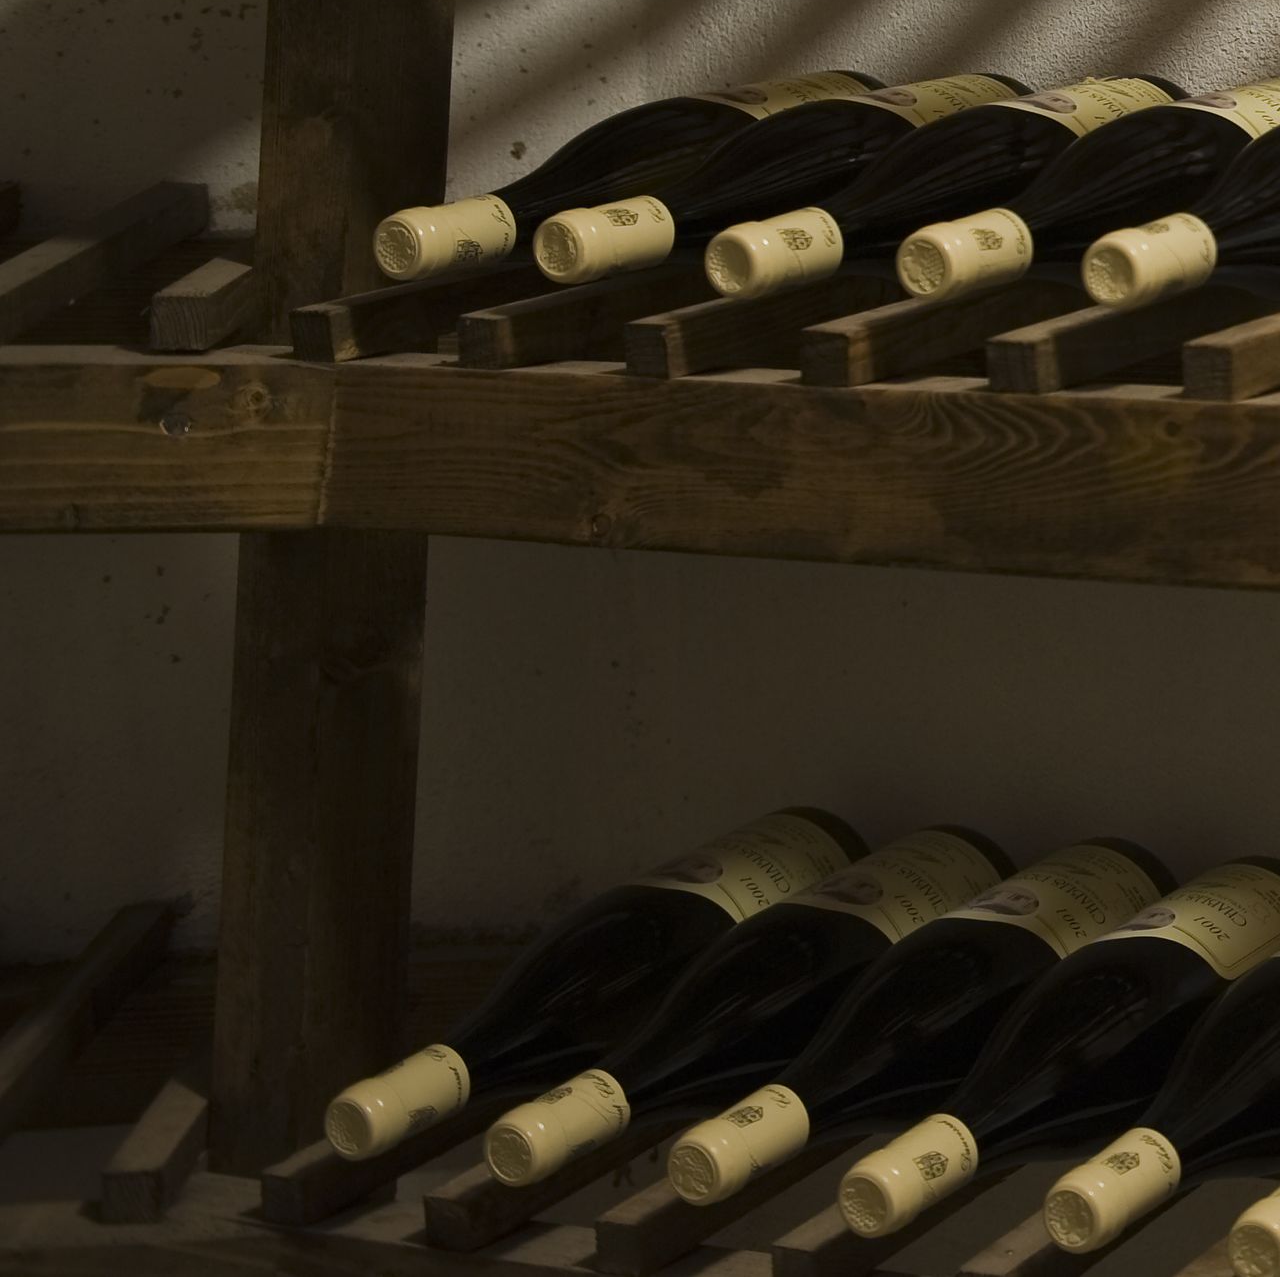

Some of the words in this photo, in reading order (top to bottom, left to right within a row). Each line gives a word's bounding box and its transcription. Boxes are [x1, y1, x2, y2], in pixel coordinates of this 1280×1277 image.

[740, 876, 770, 906] 2001
[894, 894, 925, 923] 2001
[1056, 908, 1087, 938] 2001
[1193, 916, 1230, 941] 2001
